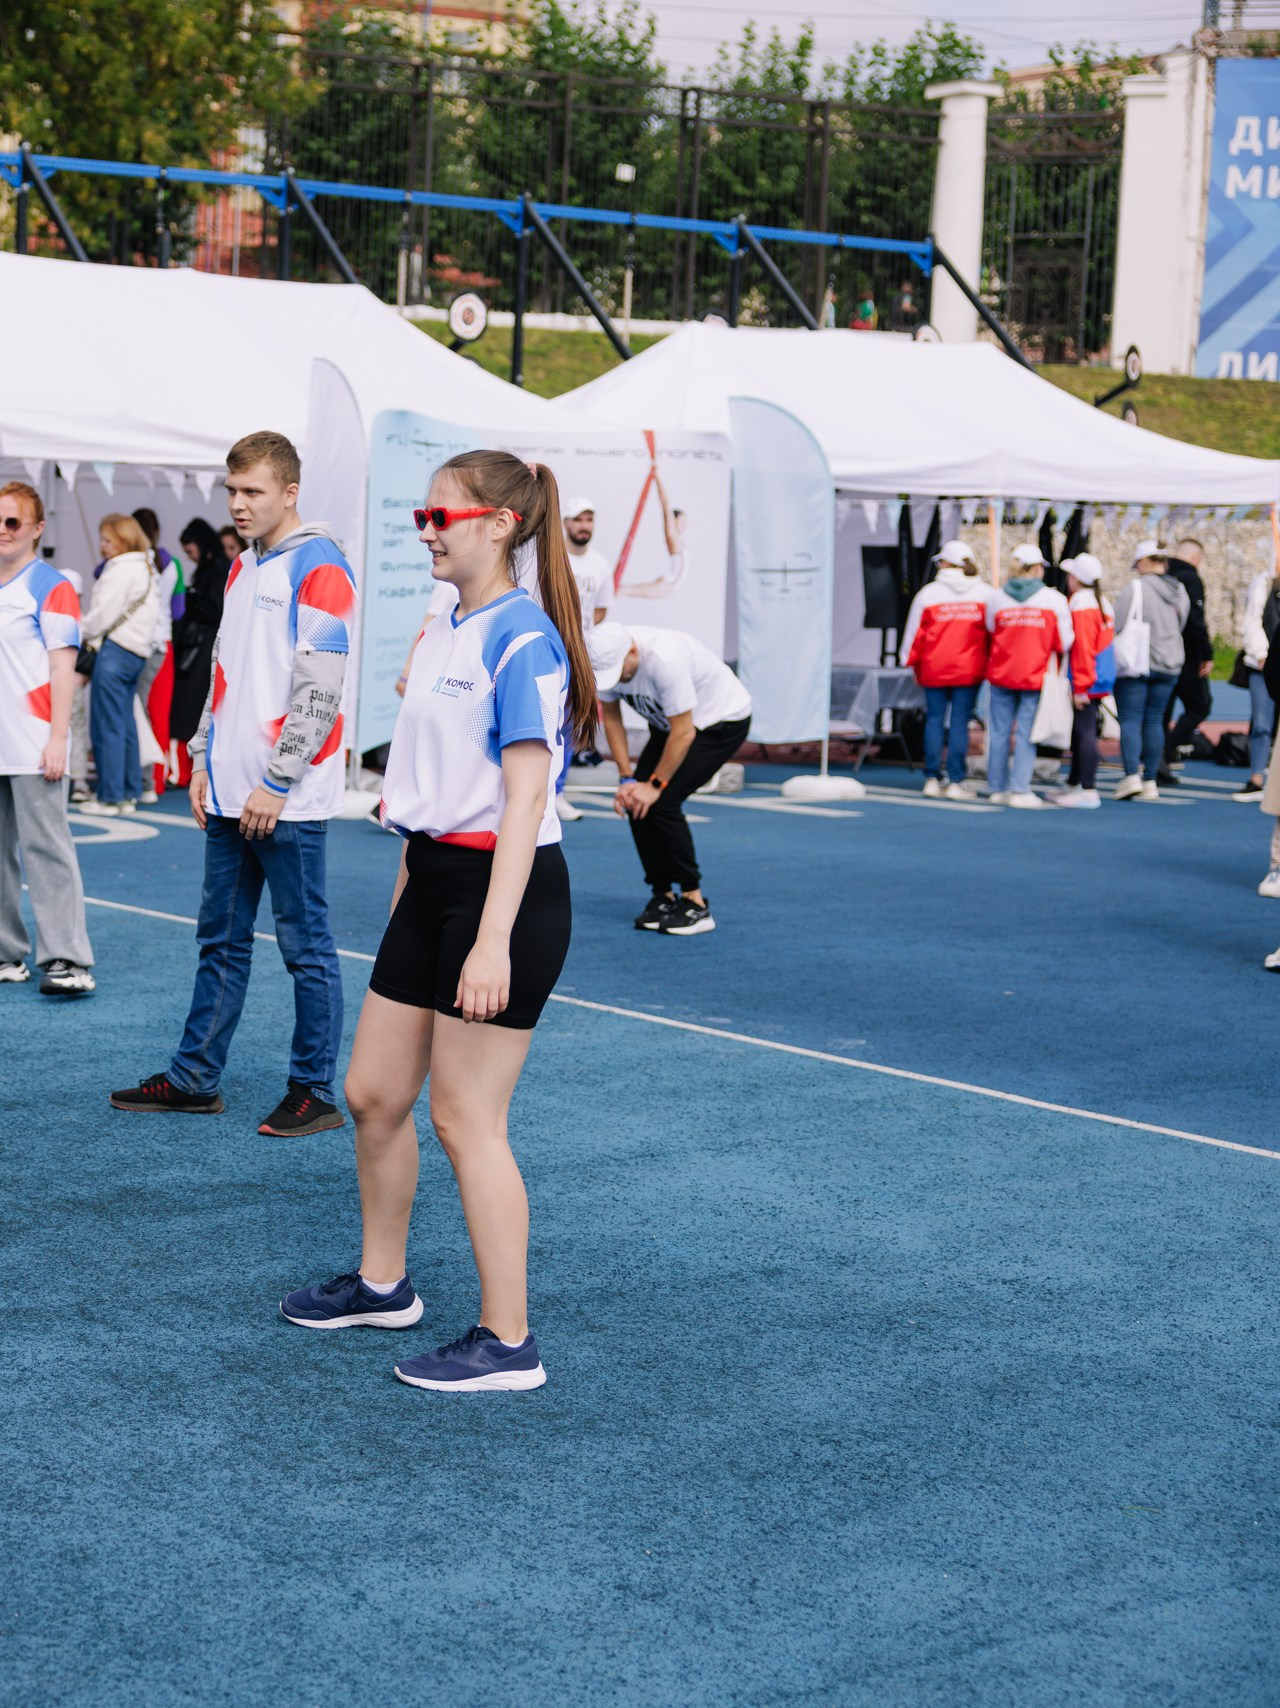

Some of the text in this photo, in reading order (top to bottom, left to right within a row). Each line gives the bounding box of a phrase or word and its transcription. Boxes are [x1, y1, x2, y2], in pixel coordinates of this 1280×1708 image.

[445, 677, 474, 691] КОМОС
[308, 689, 335, 704] Palm
[279, 742, 305, 757] Palm
